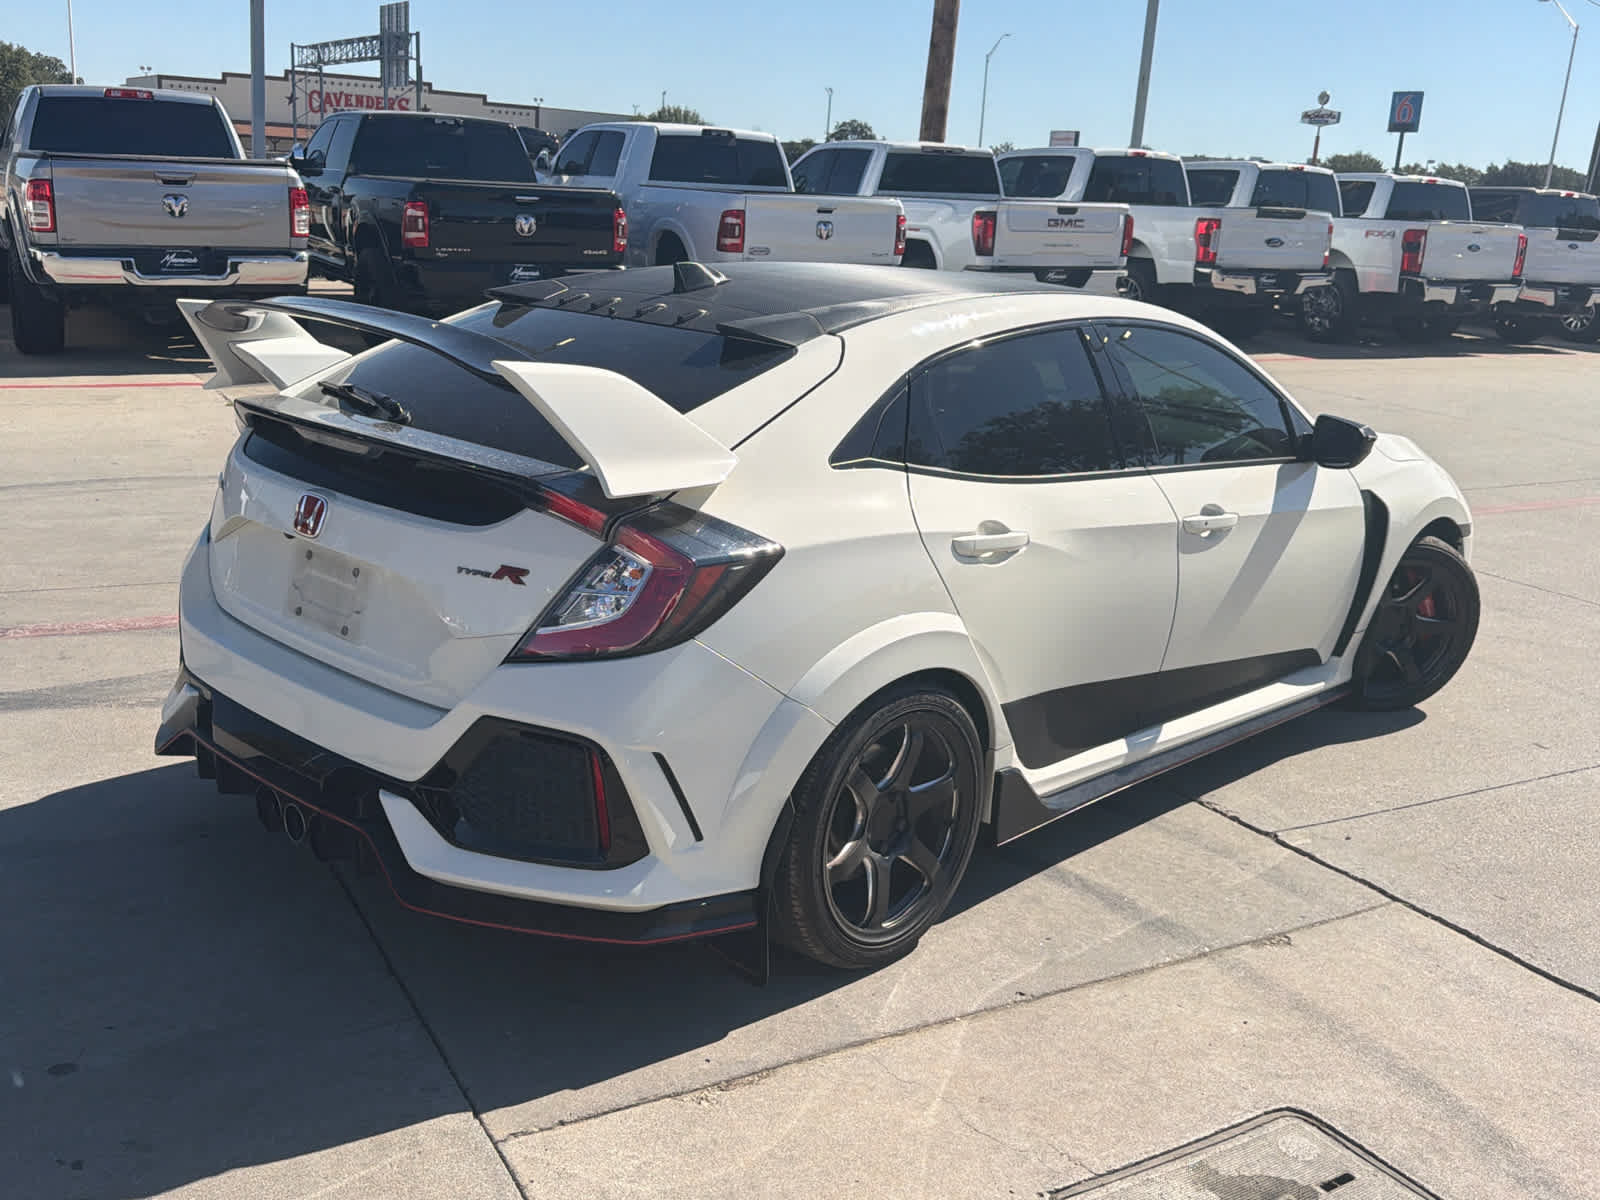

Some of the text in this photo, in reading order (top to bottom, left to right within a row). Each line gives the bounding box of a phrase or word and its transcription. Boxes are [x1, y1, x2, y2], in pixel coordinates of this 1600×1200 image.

[1396, 94, 1414, 123] 6
[1047, 218, 1085, 229] GMC
[1364, 230, 1396, 240] FX4
[457, 564, 530, 586] TYPE R
